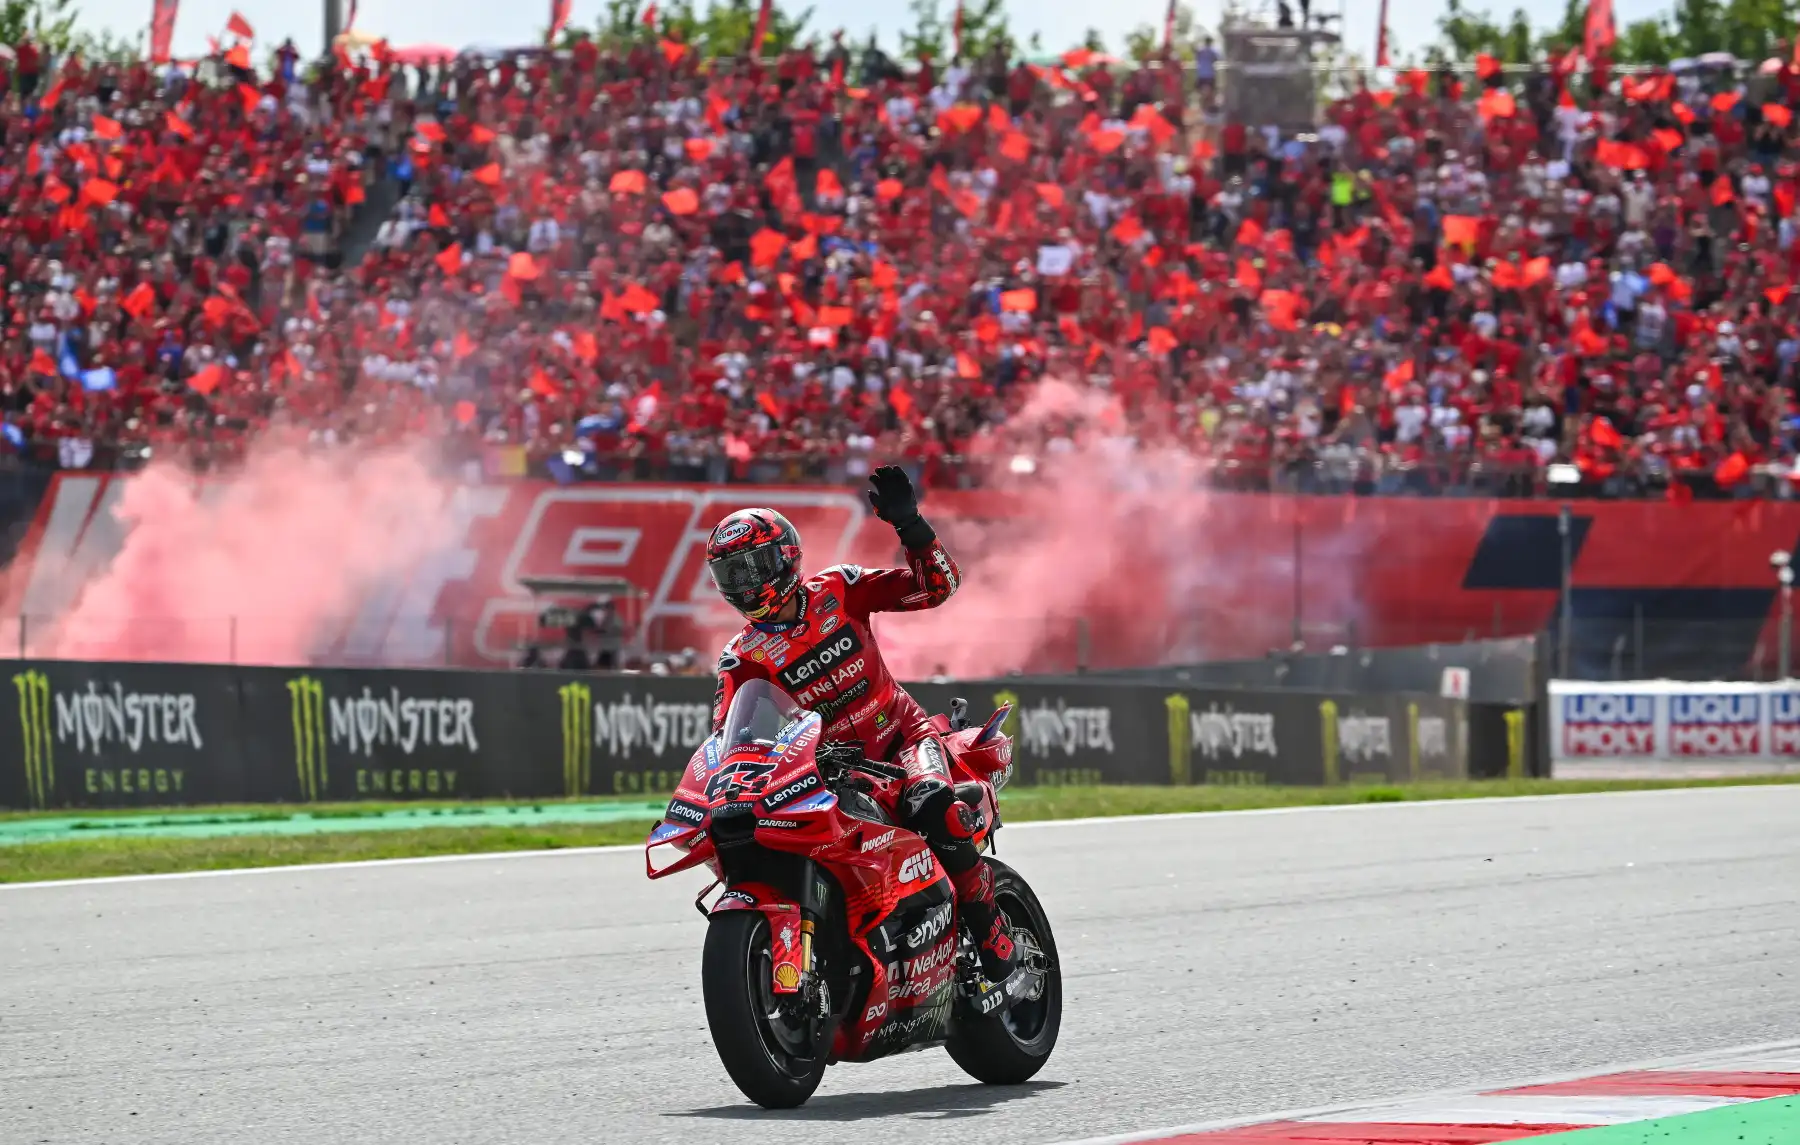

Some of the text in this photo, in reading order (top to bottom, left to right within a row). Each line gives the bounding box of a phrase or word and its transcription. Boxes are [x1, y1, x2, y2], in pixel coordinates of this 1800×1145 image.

[717, 525, 748, 541] SUOMY
[780, 574, 799, 597] Lenovo
[798, 595, 807, 620] Lenovo
[774, 624, 787, 632] TIM
[784, 637, 853, 686] Lenovo
[812, 658, 865, 697] NetApp
[54, 679, 203, 756] MONSTER
[1565, 694, 1653, 721] LIQUI
[1671, 694, 1758, 721] LIQUI
[328, 685, 480, 758] MONSTER
[593, 691, 712, 760] MONSTER
[1566, 724, 1652, 753] MOLY
[1672, 724, 1758, 753] MOLY
[84, 768, 185, 793] ENERGY
[355, 768, 457, 793] ENERGY
[612, 769, 682, 794] ENER
[764, 776, 818, 808] Lenovo
[669, 801, 705, 823] Lenovo
[758, 819, 797, 828] CARRERA
[662, 828, 680, 839] TIM
[861, 829, 896, 854] DUCATI
[898, 847, 934, 884] GIVI
[879, 903, 953, 953] Lenovo
[911, 936, 955, 979] NetApp
